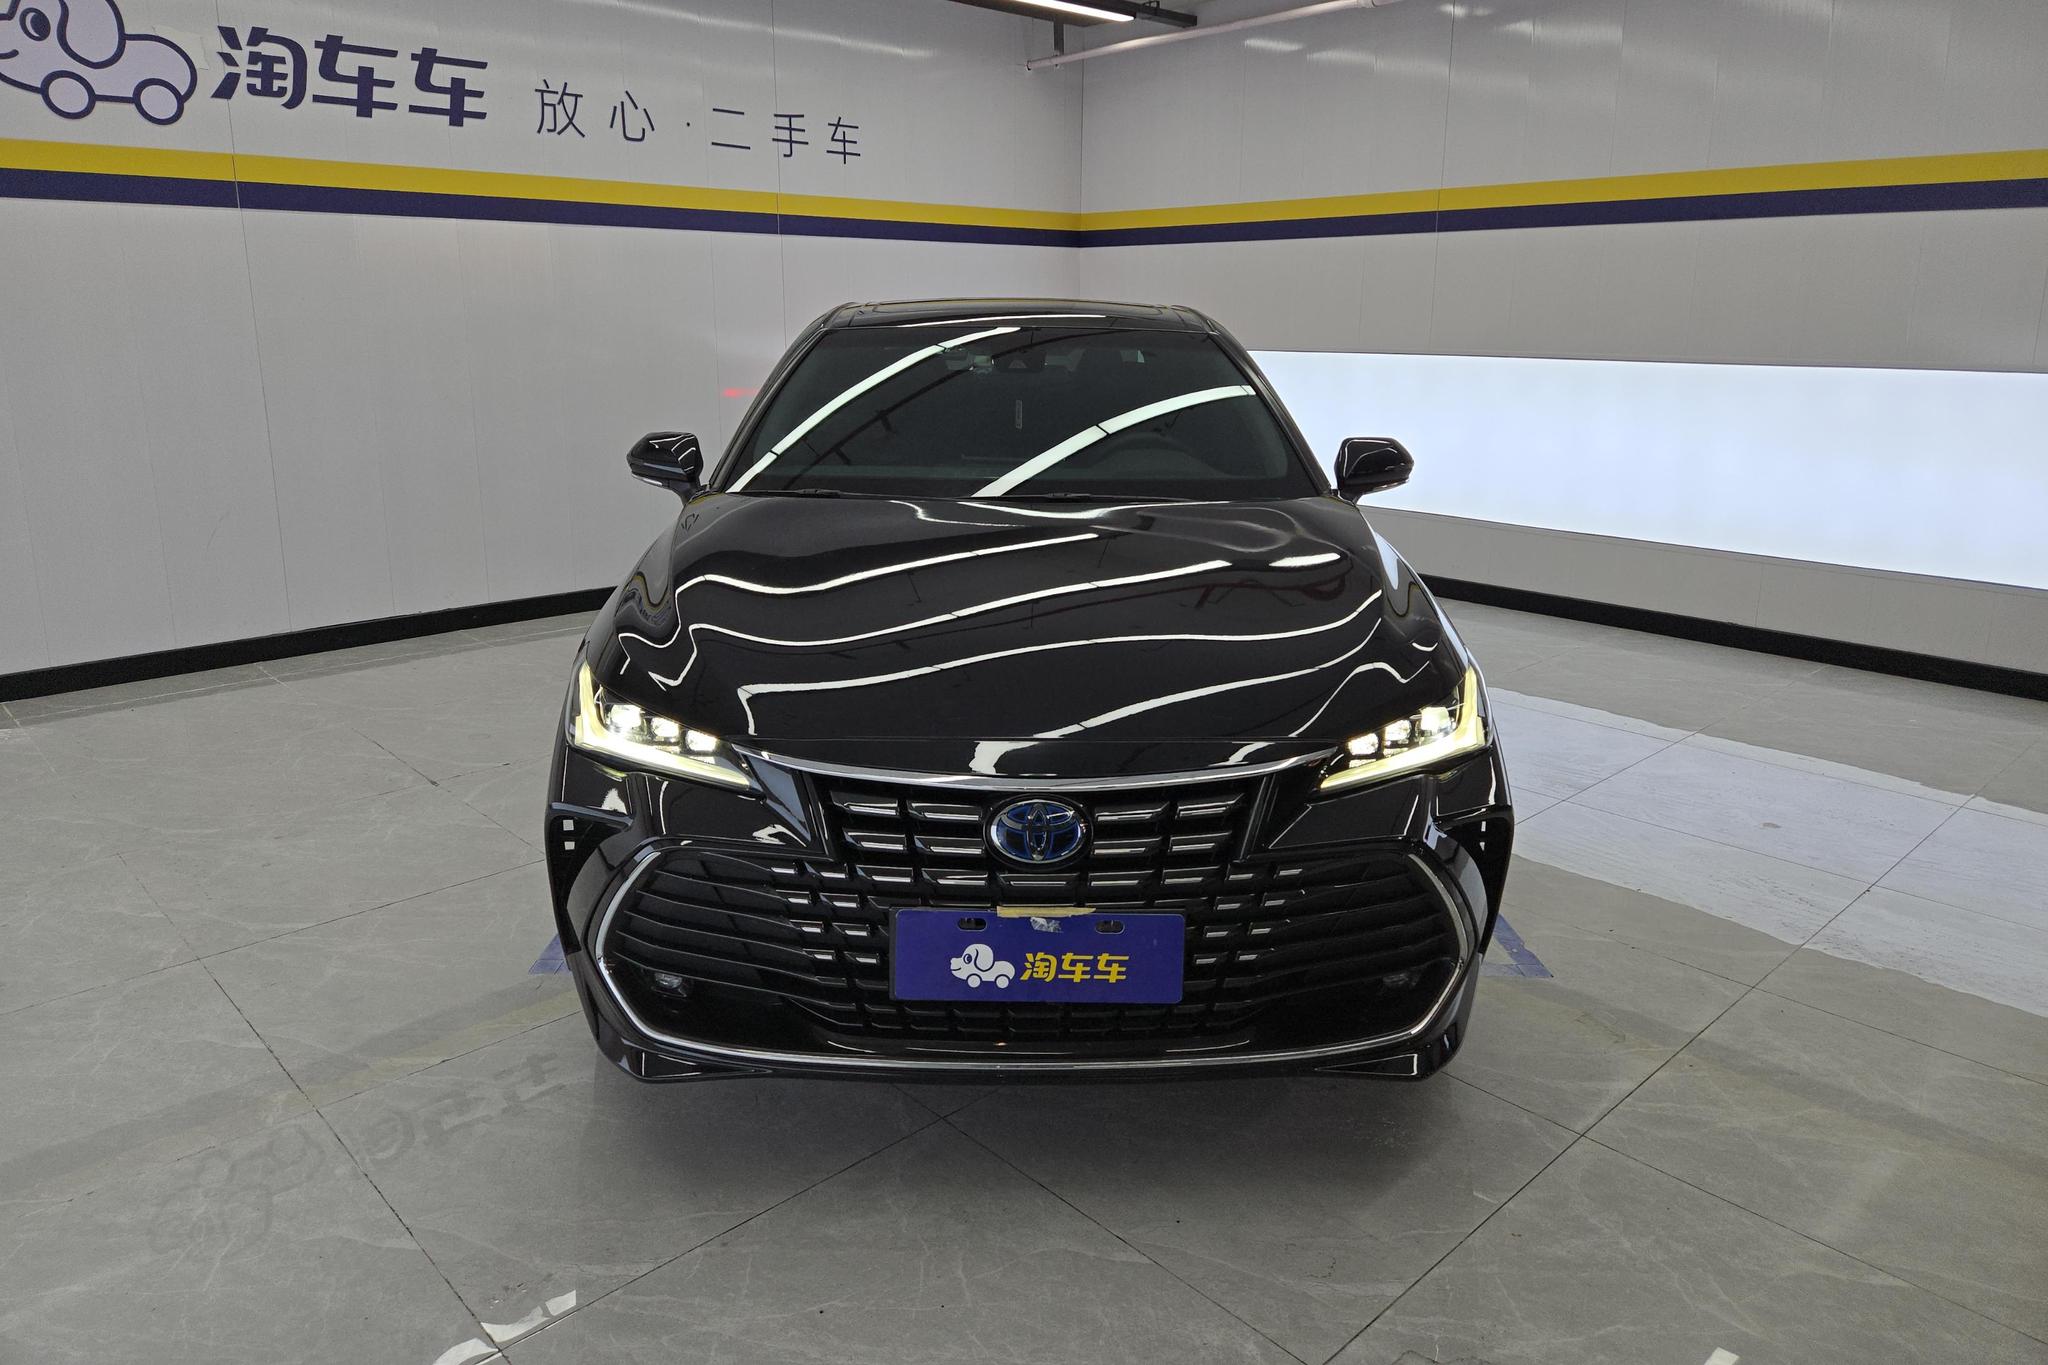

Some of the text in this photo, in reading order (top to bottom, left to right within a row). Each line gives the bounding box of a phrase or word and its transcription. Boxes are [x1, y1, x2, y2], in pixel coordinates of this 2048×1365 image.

[211, 26, 488, 128] 淘车车
[1020, 951, 1129, 984] 淘车车
